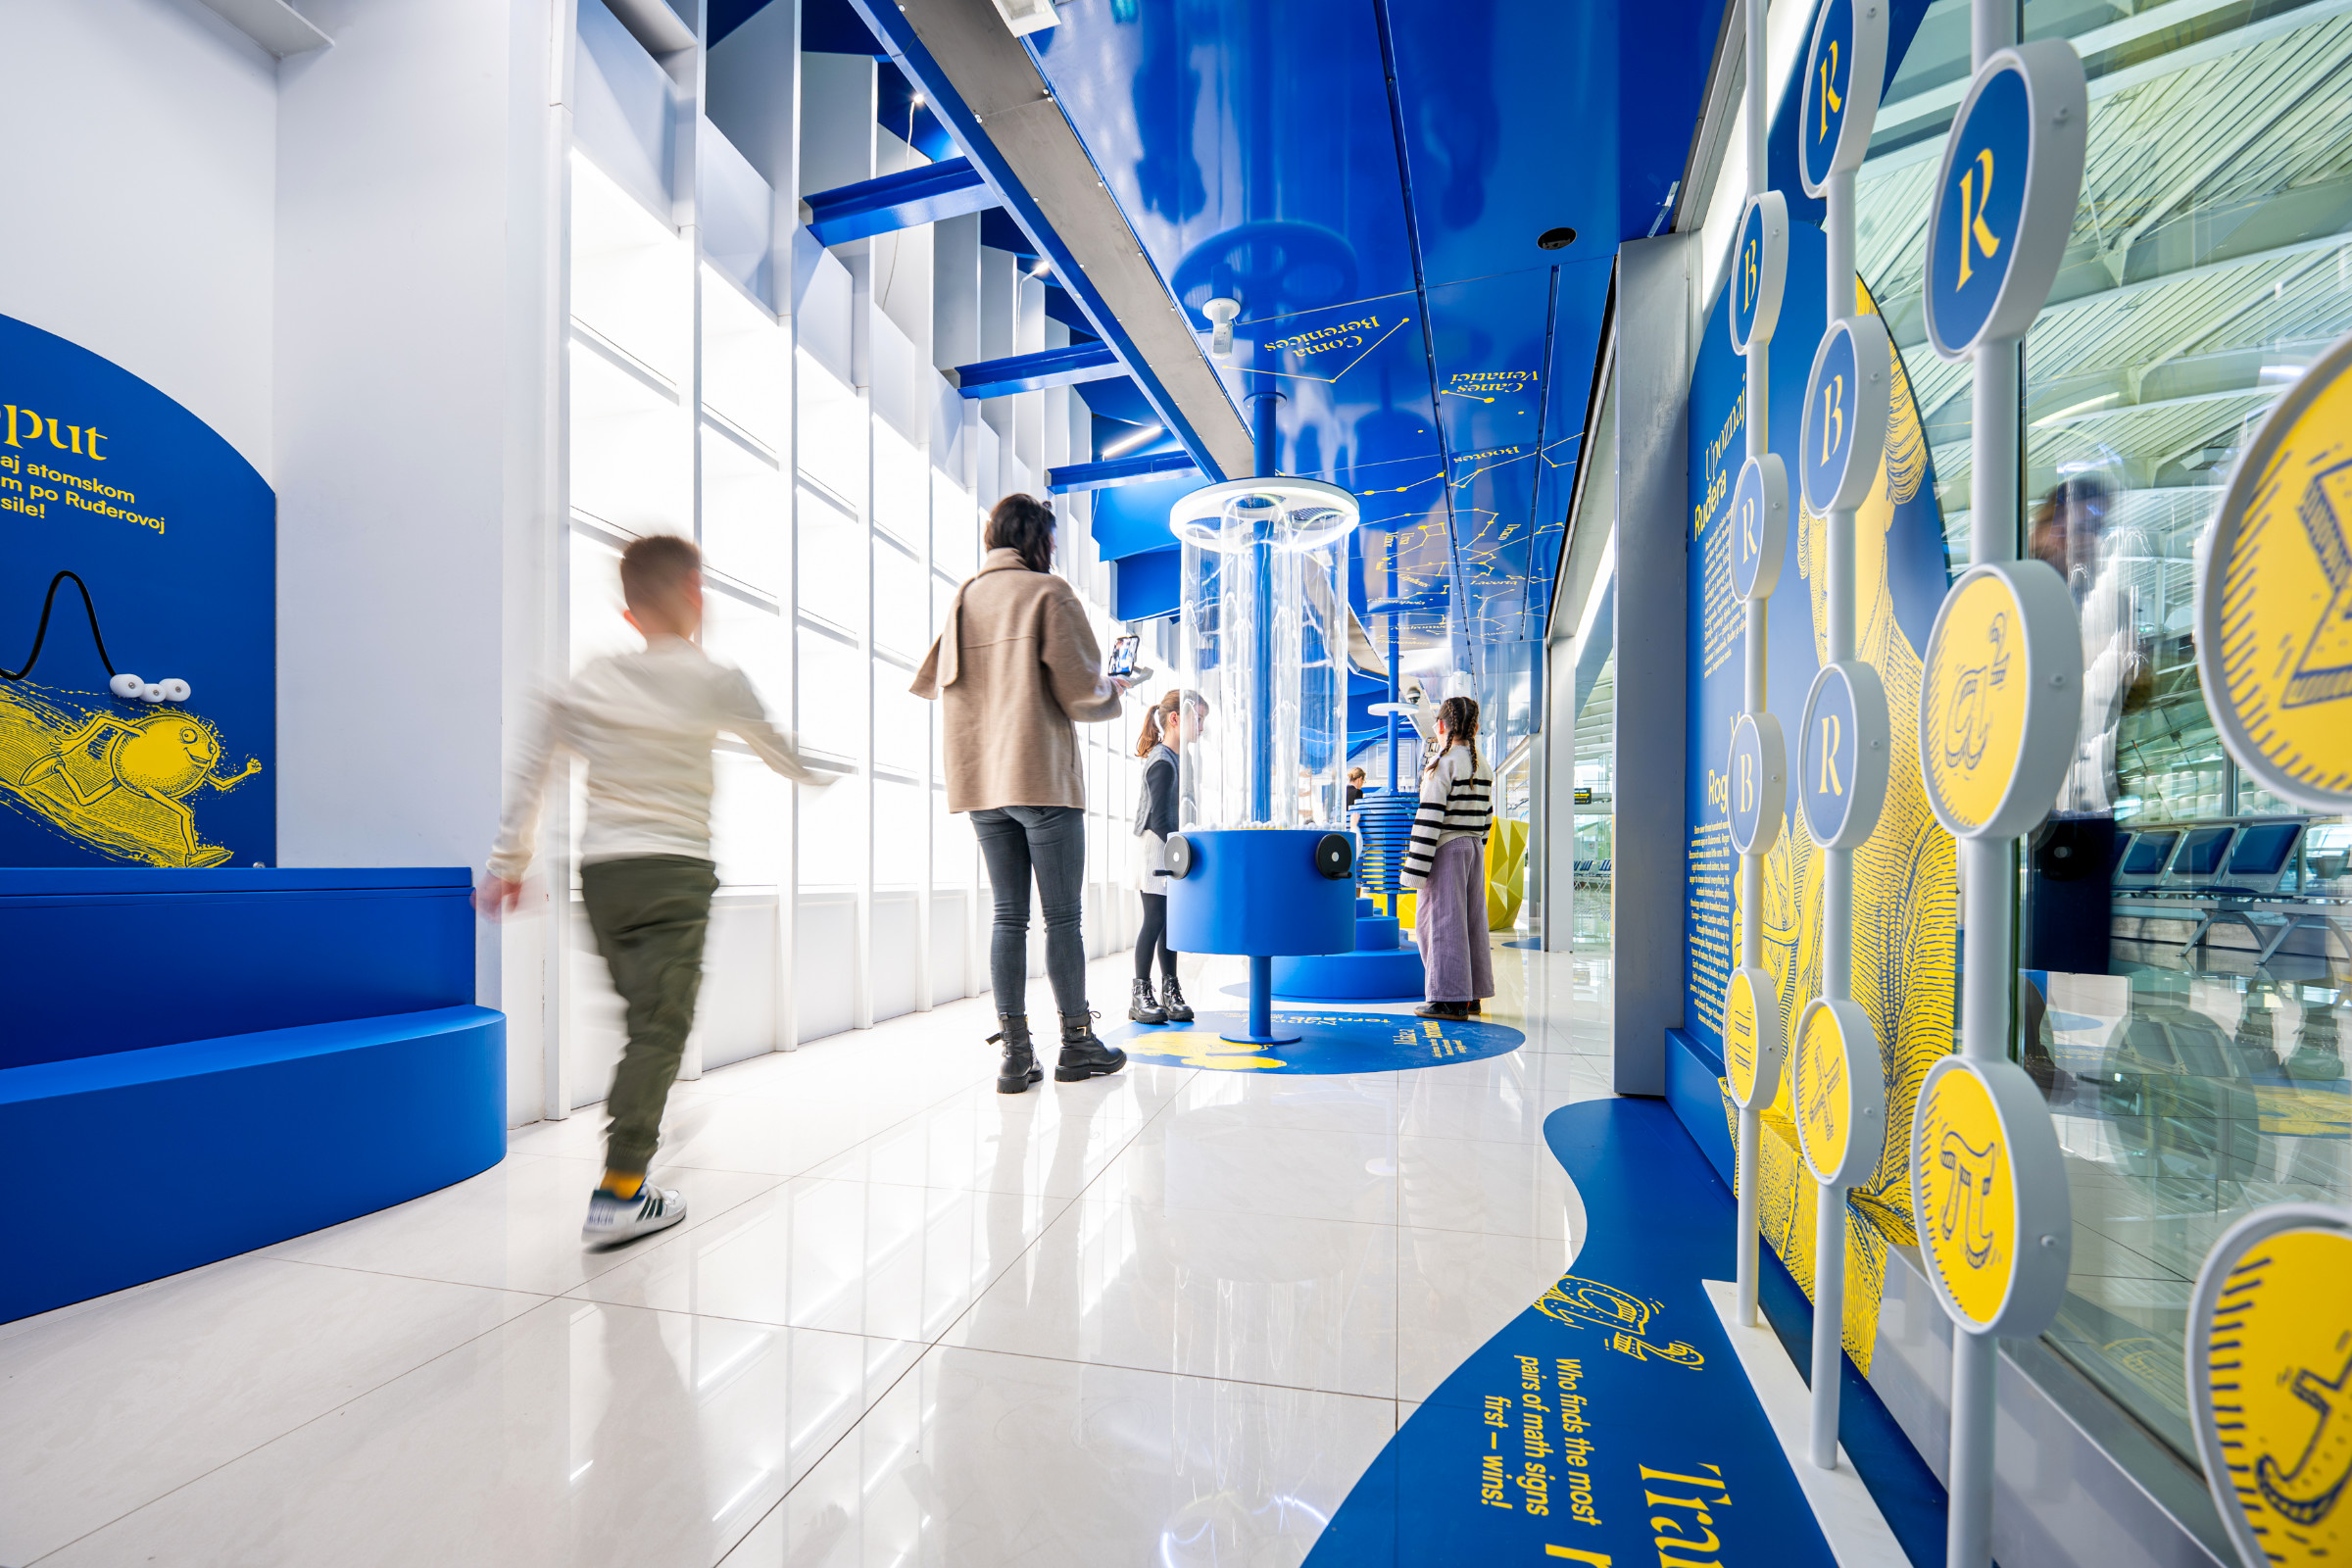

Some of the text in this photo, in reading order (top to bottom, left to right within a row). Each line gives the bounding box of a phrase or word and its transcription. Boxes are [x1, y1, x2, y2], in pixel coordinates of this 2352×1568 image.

[1819, 39, 1842, 145] R
[1955, 147, 2000, 293] R
[1743, 238, 1757, 315] B
[1264, 316, 1381, 353] Berenices
[1292, 334, 1362, 358] Coma
[1450, 370, 1539, 383] Venatici
[1456, 381, 1524, 393] Canes
[0, 405, 108, 461] put
[1705, 372, 1745, 482] Upoznaj
[1820, 373, 1843, 468] B
[26, 463, 135, 504] atomskom
[29, 484, 59, 501] po
[65, 491, 166, 534] Ruđerovoj
[1694, 468, 1727, 542] Ruđera
[1742, 497, 1757, 564] R
[1819, 714, 1843, 796] R
[1708, 768, 1728, 813] Rog
[1740, 753, 1753, 812] B
[1555, 1358, 1584, 1391] Who
[1484, 1395, 1511, 1428] first
[1513, 1354, 1555, 1516] pairs of math signs
[1559, 1393, 1592, 1434] finds
[1564, 1437, 1594, 1467] the
[1481, 1455, 1513, 1509] wins!
[1568, 1471, 1602, 1526] most
